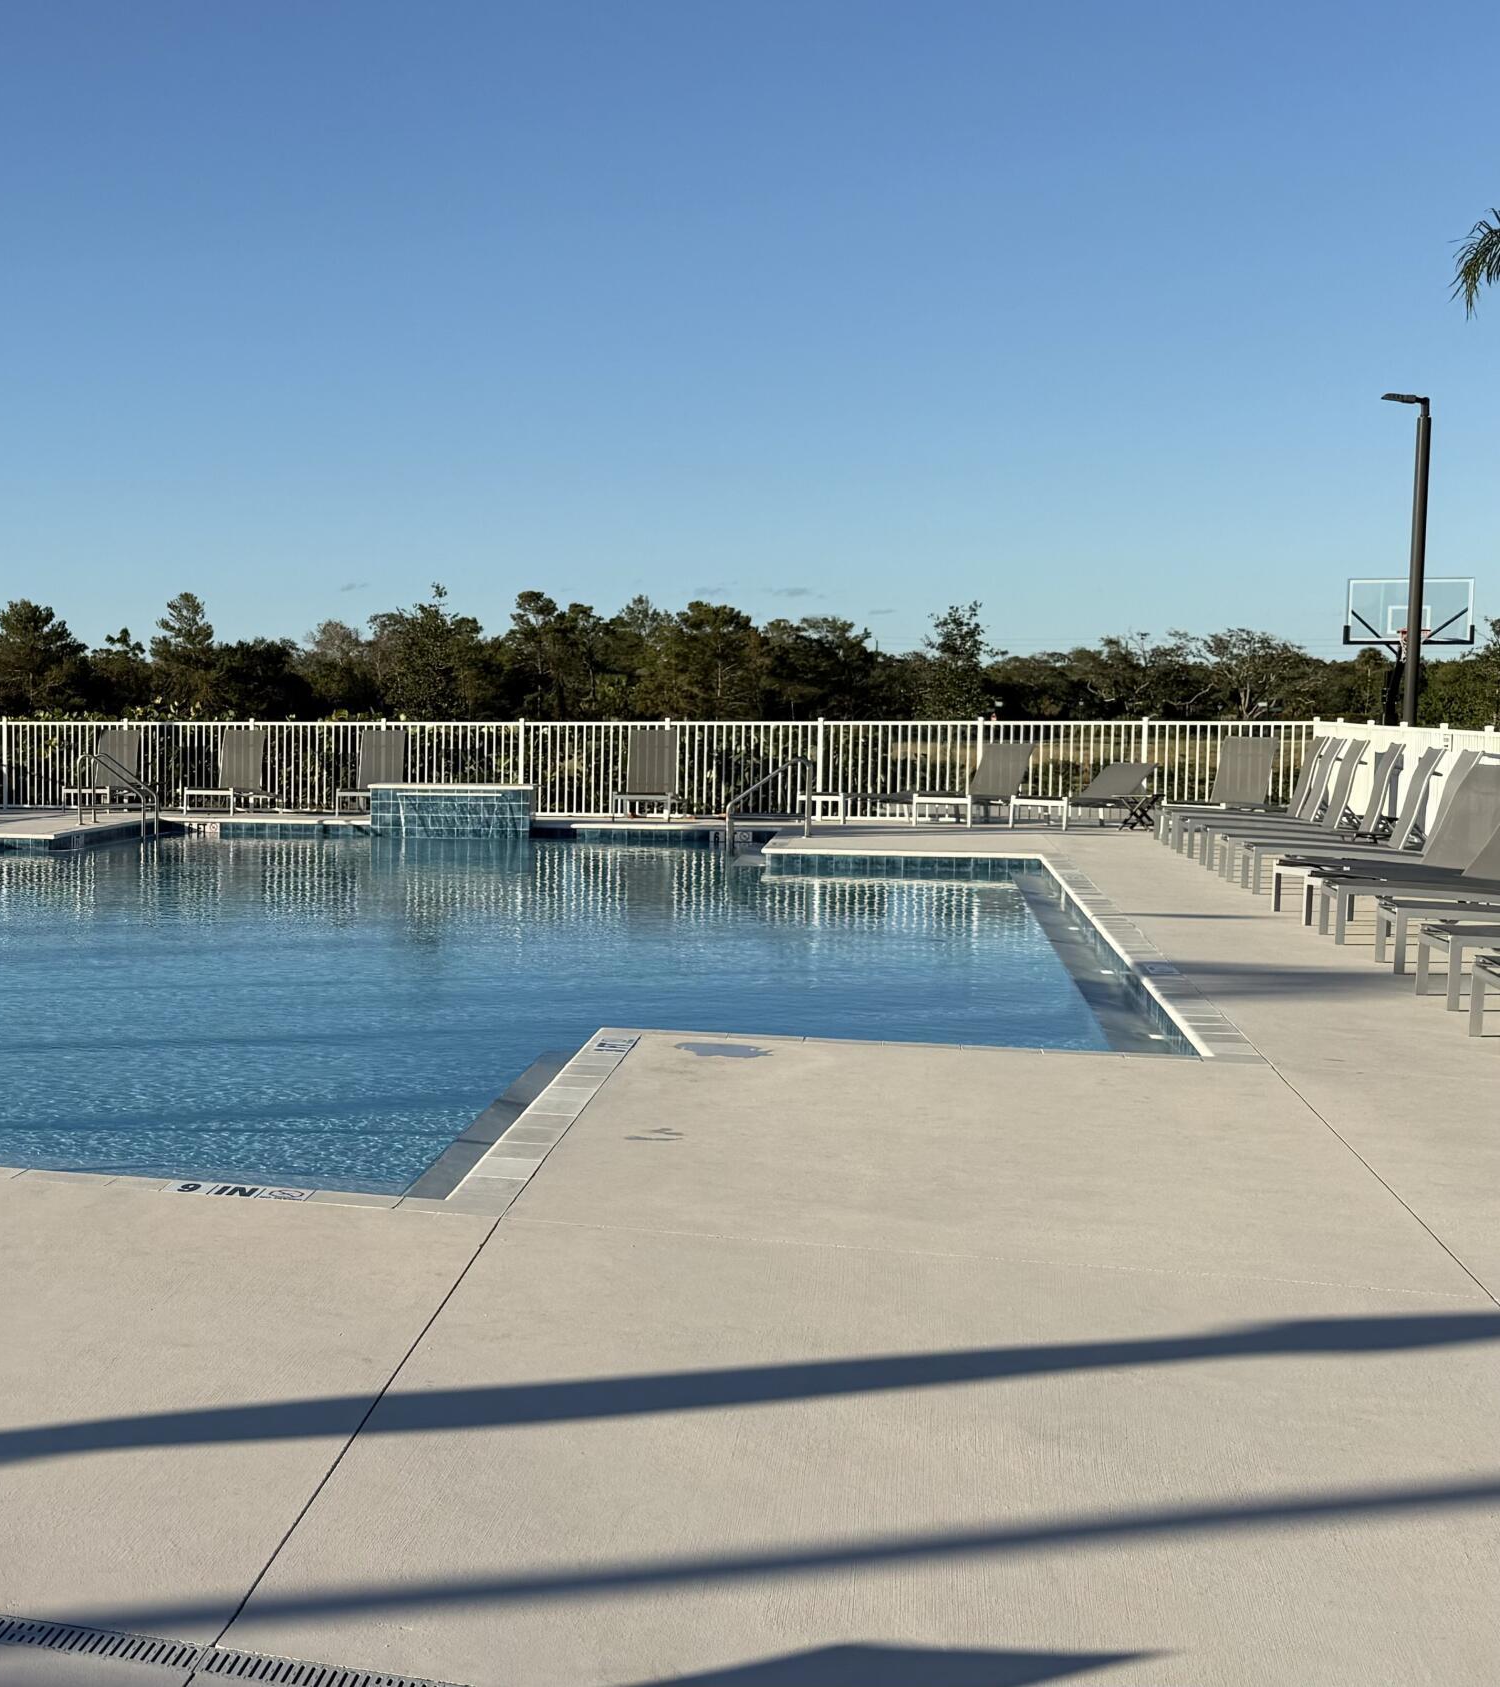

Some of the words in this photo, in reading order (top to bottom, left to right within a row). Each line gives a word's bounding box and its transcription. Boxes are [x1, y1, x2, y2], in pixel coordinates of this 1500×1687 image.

[196, 823, 208, 833] FT
[714, 831, 720, 842] 6
[177, 1183, 202, 1192] 9
[214, 1186, 259, 1197] IN
